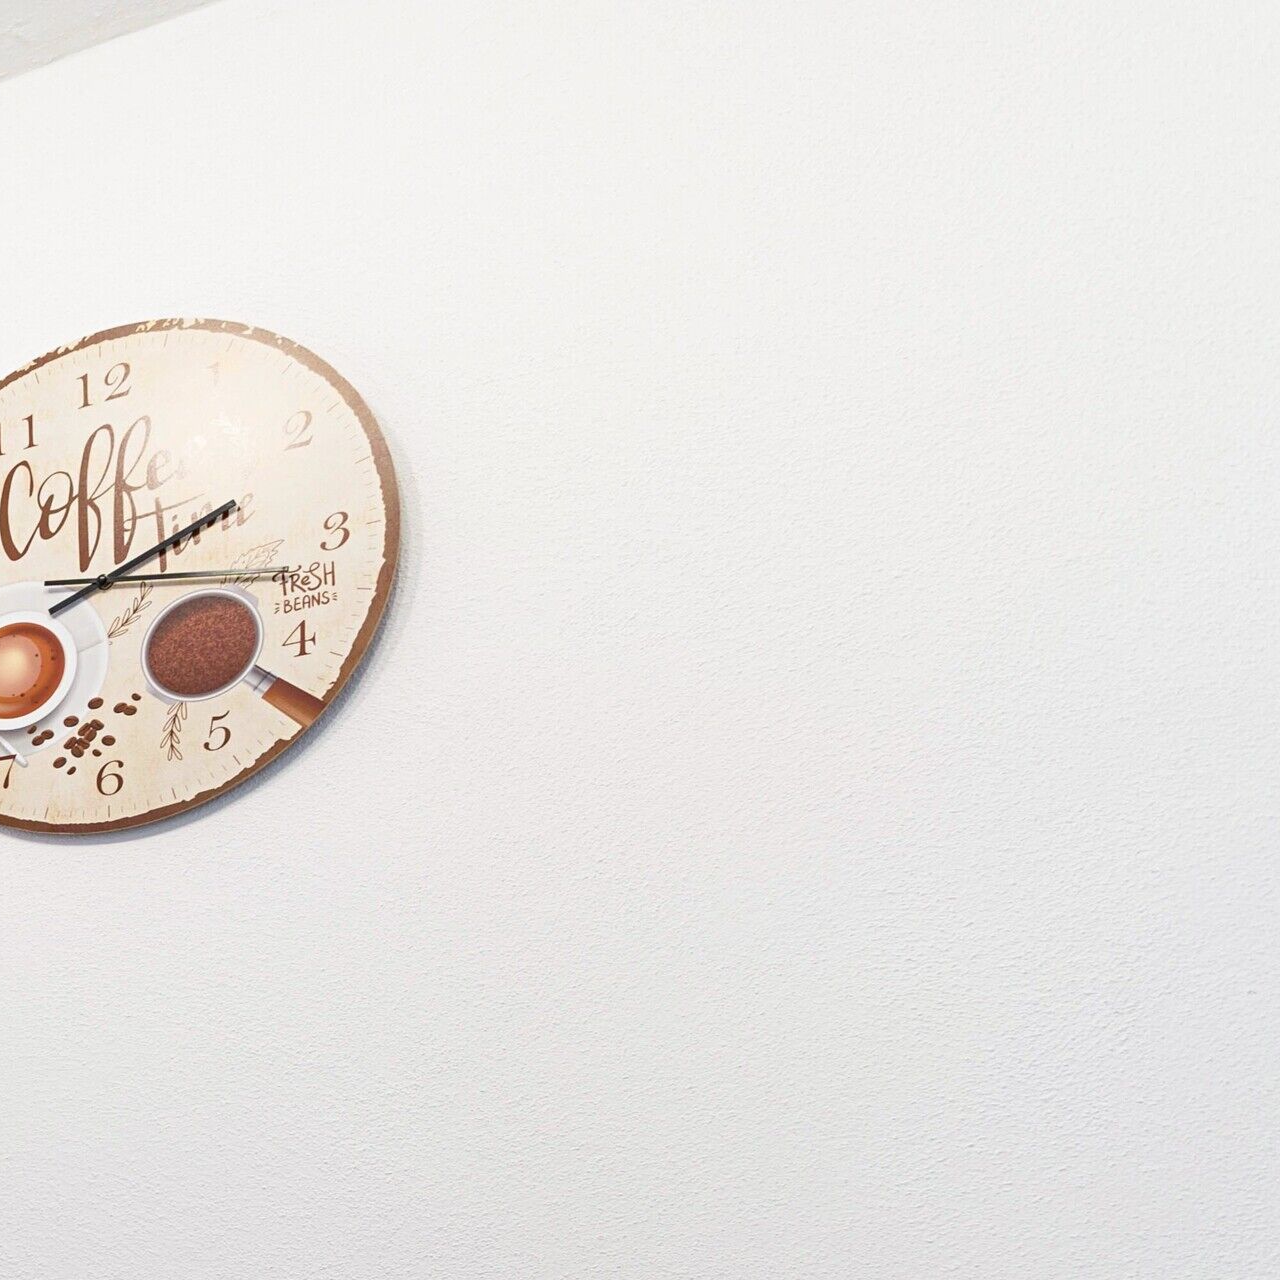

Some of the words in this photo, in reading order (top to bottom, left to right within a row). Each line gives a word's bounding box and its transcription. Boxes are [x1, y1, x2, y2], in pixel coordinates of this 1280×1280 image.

[76, 361, 132, 410] 12
[283, 410, 315, 451] 2
[0, 415, 190, 573] Coffe
[320, 511, 351, 551] 3
[283, 591, 330, 614] BEANS
[281, 620, 317, 659] 4
[203, 709, 231, 752] 5
[96, 759, 125, 796] 6
